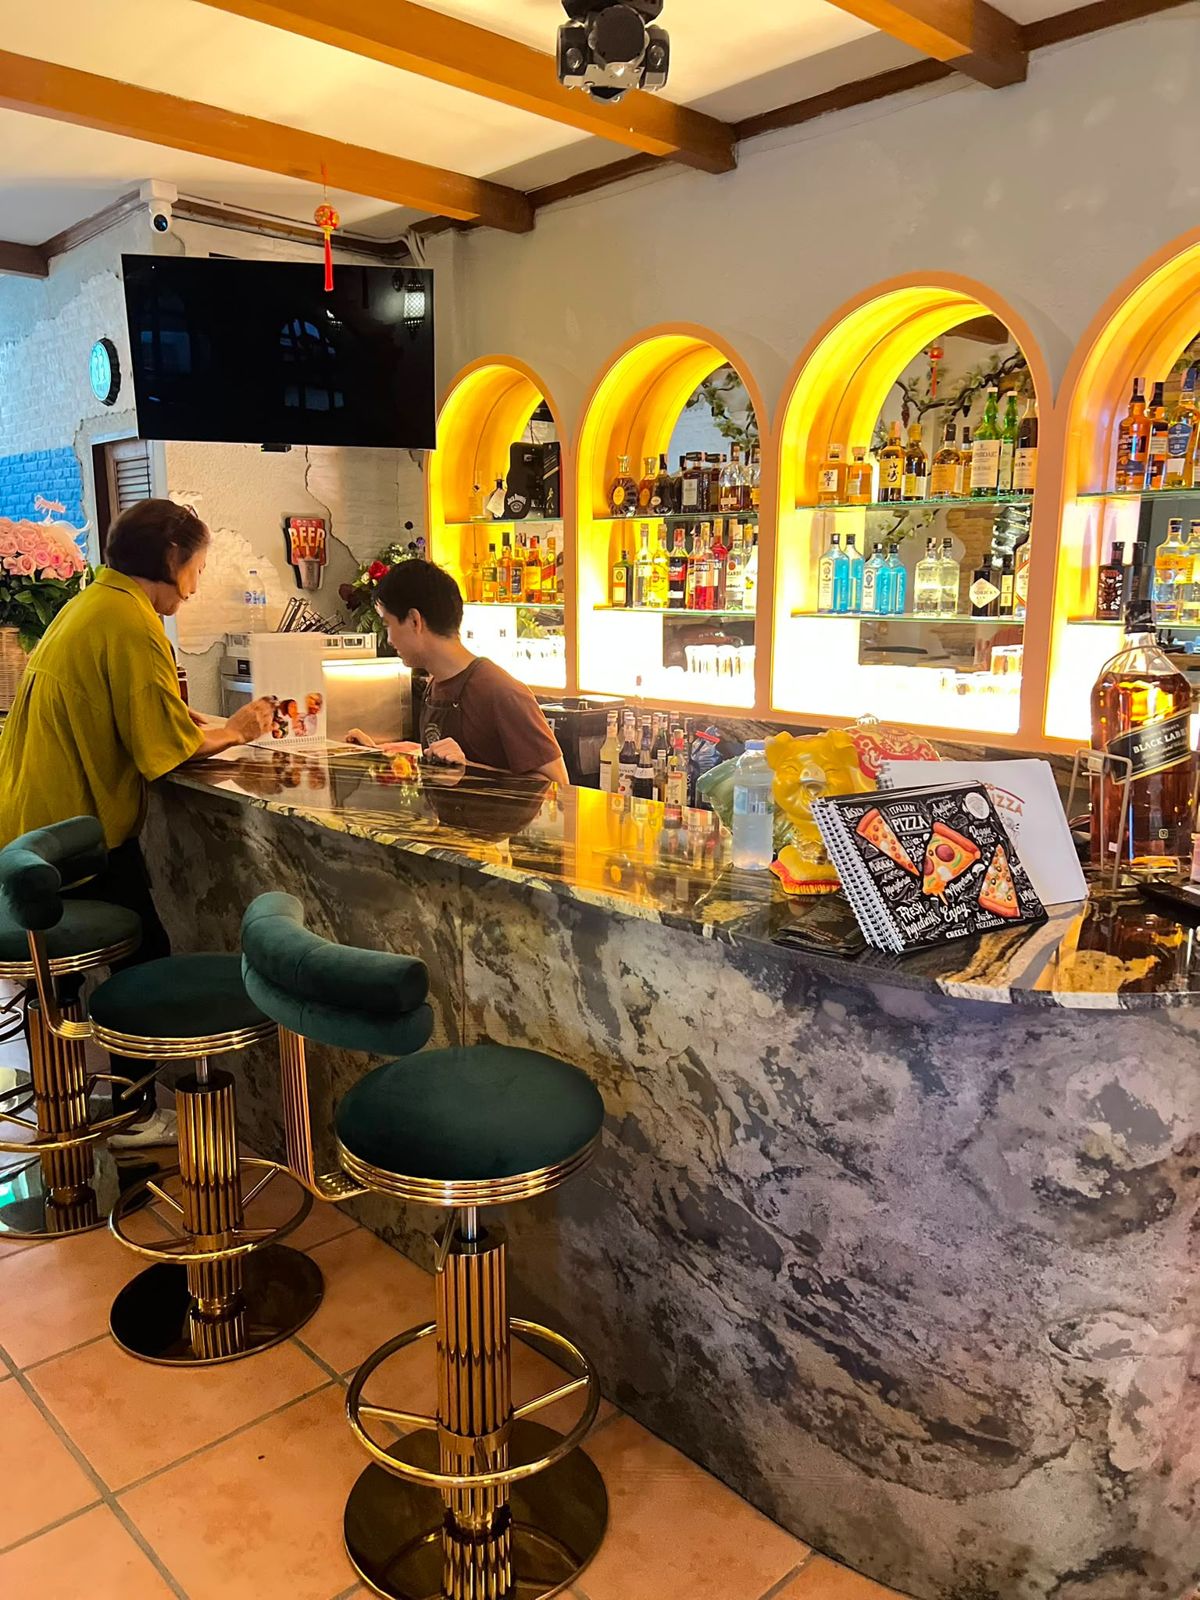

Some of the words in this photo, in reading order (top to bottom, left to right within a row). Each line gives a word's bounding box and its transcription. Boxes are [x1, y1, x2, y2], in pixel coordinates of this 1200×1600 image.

[288, 526, 326, 549] BEER
[1132, 737, 1164, 754] BLACK
[888, 804, 916, 815] ITALIAN
[991, 793, 1023, 817] IZZA
[891, 815, 930, 832] PIZZA
[940, 902, 972, 922] Enjoy
[945, 928, 969, 939] CHEESE
